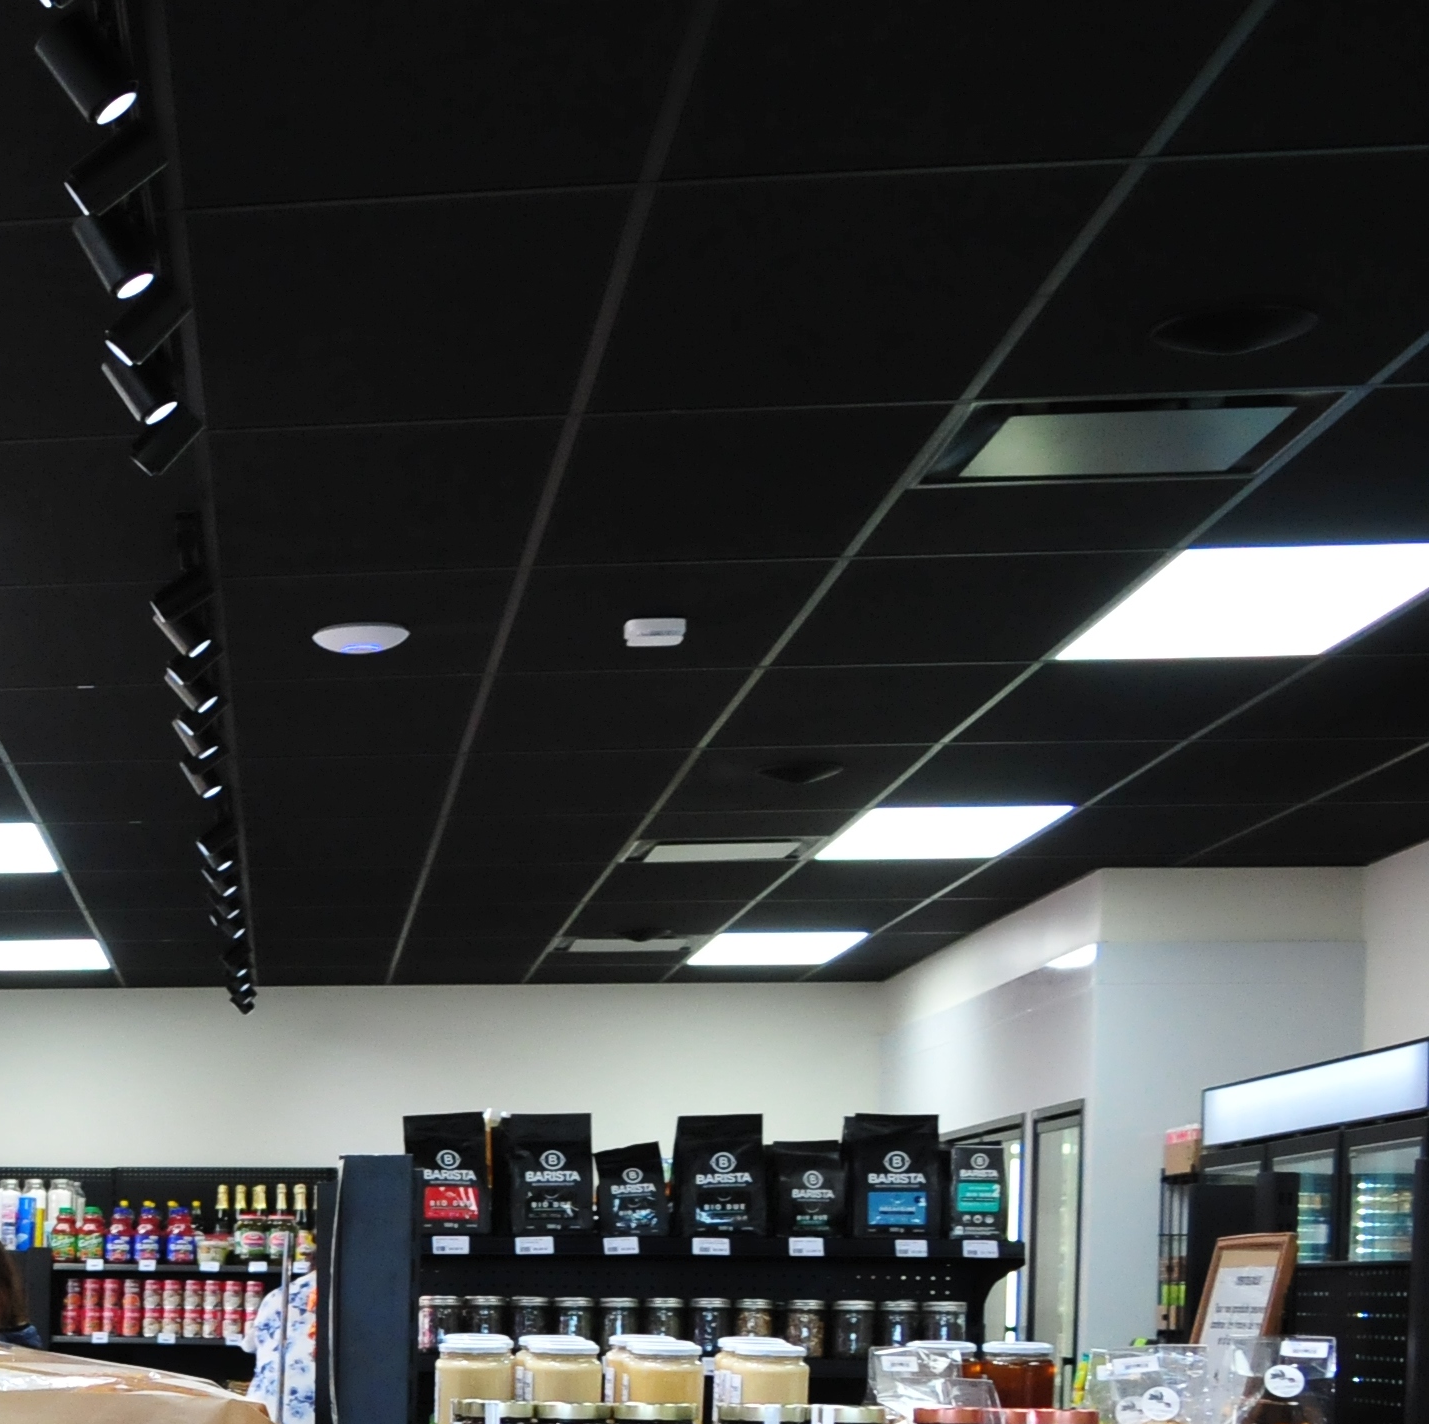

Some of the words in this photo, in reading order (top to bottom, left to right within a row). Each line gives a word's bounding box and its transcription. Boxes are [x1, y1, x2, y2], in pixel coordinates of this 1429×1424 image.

[423, 1169, 477, 1181] BARISTA
[525, 1171, 581, 1182] BARISTA
[695, 1172, 753, 1185] BARISTA
[867, 1173, 926, 1184] BARISTA
[610, 1183, 657, 1194] BARISTA
[791, 1189, 835, 1199] BARISTA
